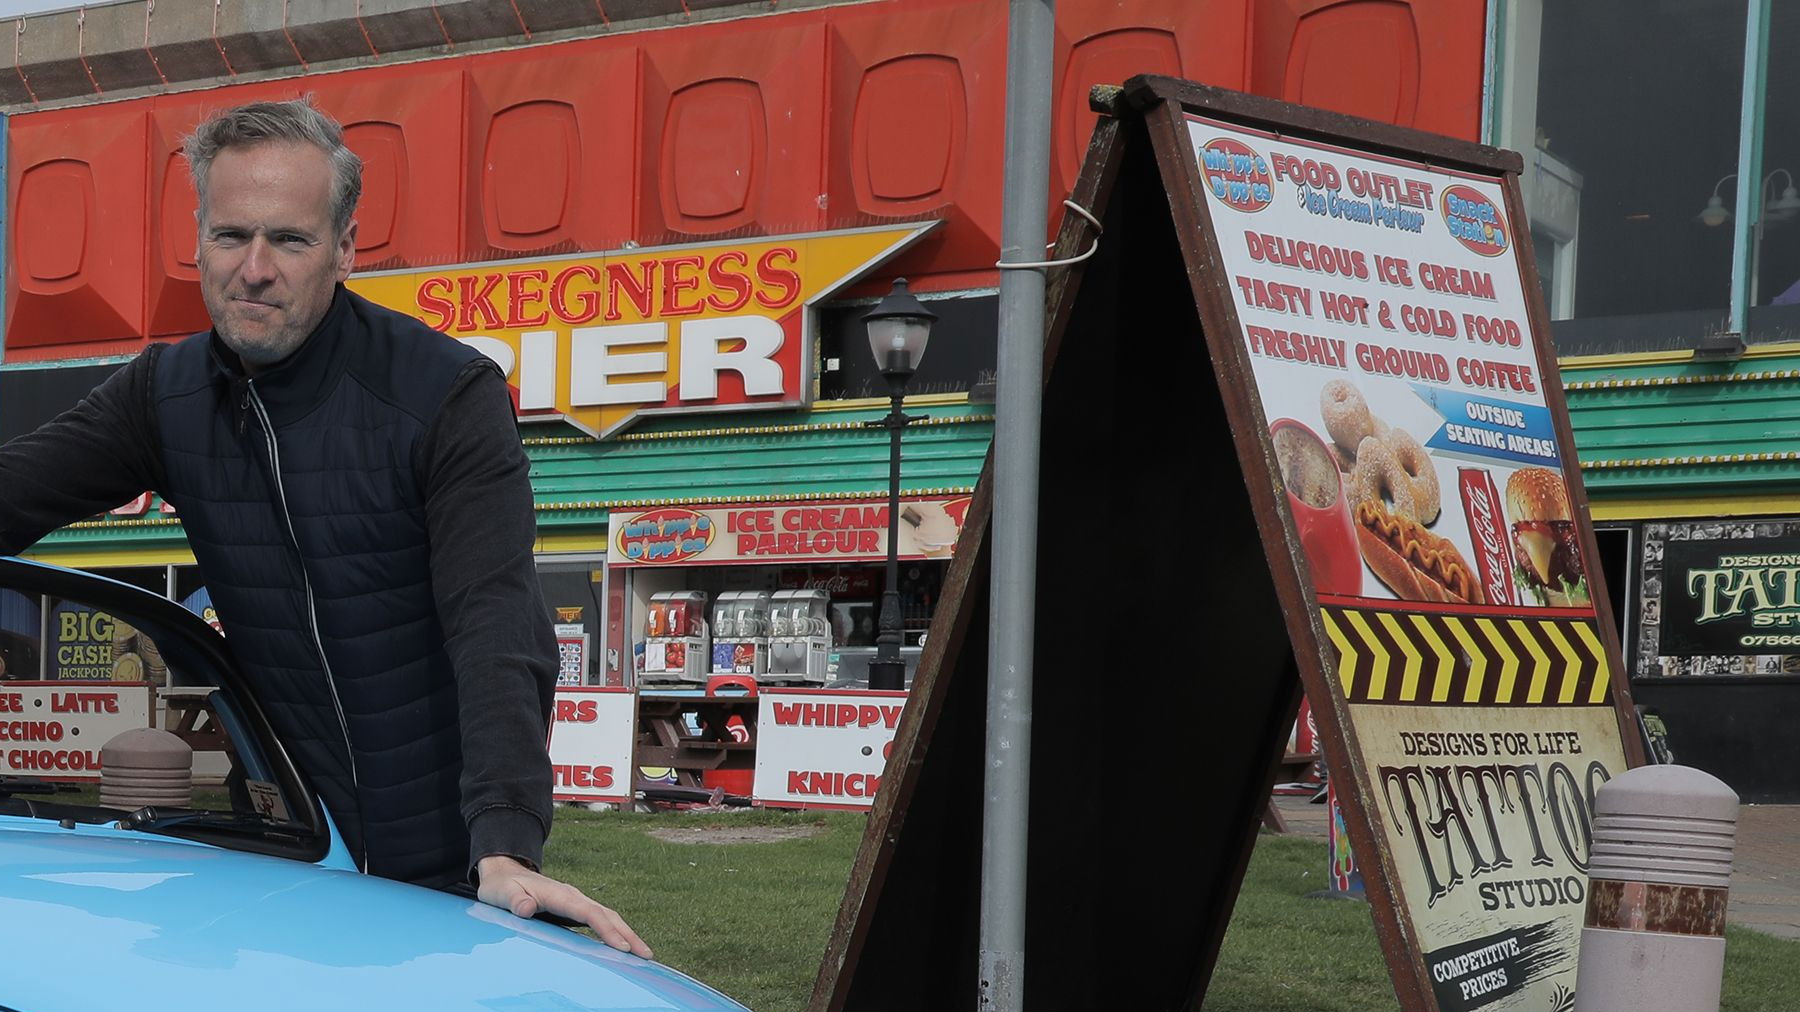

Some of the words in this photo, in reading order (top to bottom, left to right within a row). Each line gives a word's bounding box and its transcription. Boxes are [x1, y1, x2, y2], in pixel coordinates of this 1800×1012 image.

[1270, 150, 1343, 191] FOOD
[1347, 166, 1434, 211] OUTLET
[1305, 184, 1327, 217] Ice
[1327, 189, 1373, 225] Cream
[1447, 192, 1499, 225] Snack
[1244, 230, 1369, 281] DELICIOUS
[1374, 253, 1414, 288] ICE
[1418, 261, 1498, 301] CREAM
[416, 247, 801, 333] SKEGNESS
[1235, 274, 1313, 317] TASTY
[1319, 289, 1369, 327] HOT
[1377, 299, 1397, 330] &
[1400, 303, 1457, 340] COLD
[1462, 313, 1523, 350] FOOD
[1245, 323, 1348, 370] FRESHLY
[1354, 342, 1451, 384] GROUND
[1456, 356, 1538, 395] COFFEE
[1465, 400, 1526, 429] OUTSIDE
[1445, 422, 1505, 451] SEATING
[1507, 432, 1557, 459] AREAS!
[727, 510, 776, 533] ICE
[781, 507, 890, 531] CREAM
[736, 530, 880, 556] PARLOUR
[1720, 555, 1800, 567] DESIGN
[58, 611, 115, 643] BIG
[1753, 612, 1800, 626] ST
[57, 645, 113, 666] CASH
[735, 665, 752, 673] COLA
[57, 667, 113, 681] JACKPOTS
[51, 692, 119, 714] LATTE
[773, 702, 903, 729] WHIPPY
[1400, 731, 1486, 756] DESIGNS
[1489, 732, 1532, 756] FOR
[1533, 731, 1583, 755] LIFE
[1478, 875, 1585, 912] STUDIO
[1433, 936, 1521, 983] COMPETITIVE
[1459, 967, 1509, 1001] PRICES
